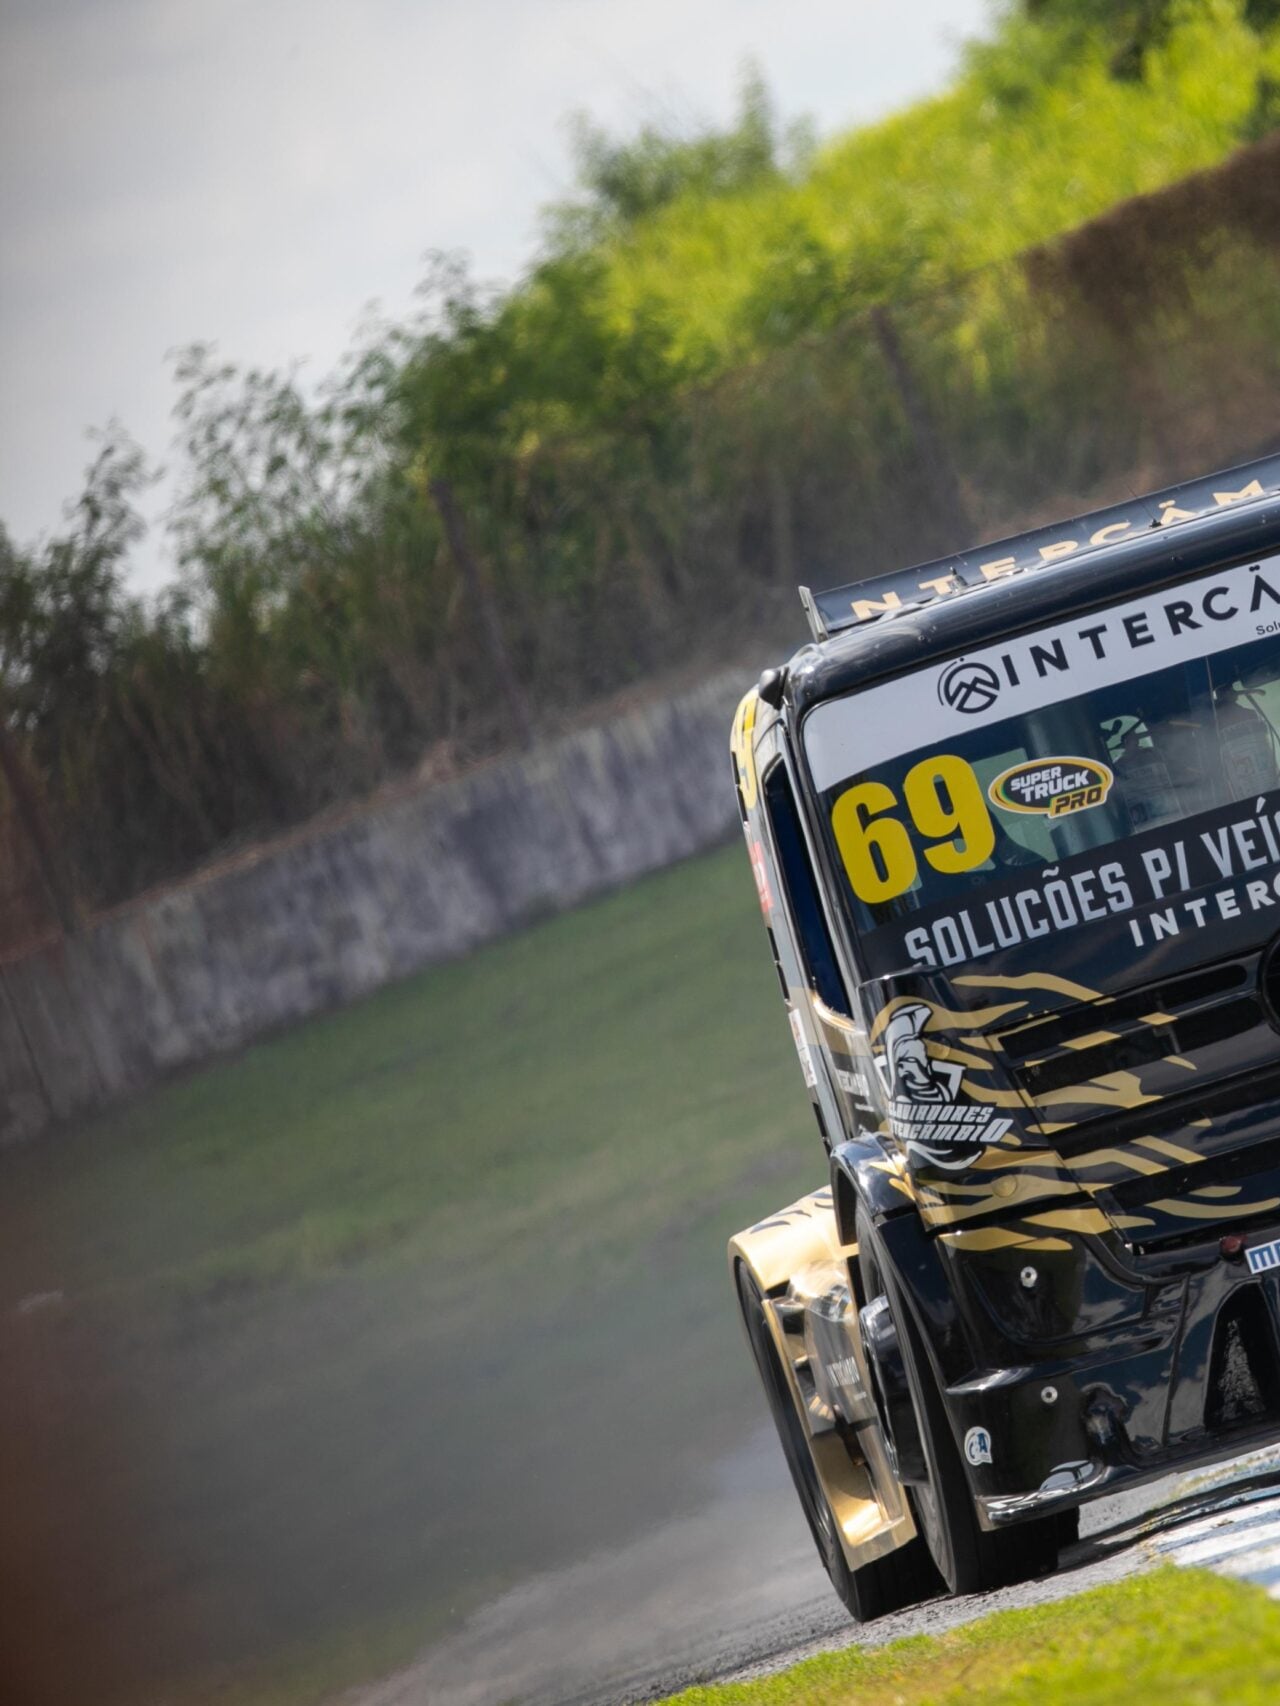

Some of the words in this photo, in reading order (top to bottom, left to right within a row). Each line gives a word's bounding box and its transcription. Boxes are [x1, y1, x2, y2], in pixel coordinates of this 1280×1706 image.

[1010, 765, 1062, 791] SUPER
[1020, 769, 1090, 803] TRUCK
[1053, 786, 1103, 814] PRO
[831, 754, 996, 905] 69
[1141, 840, 1191, 900] P/
